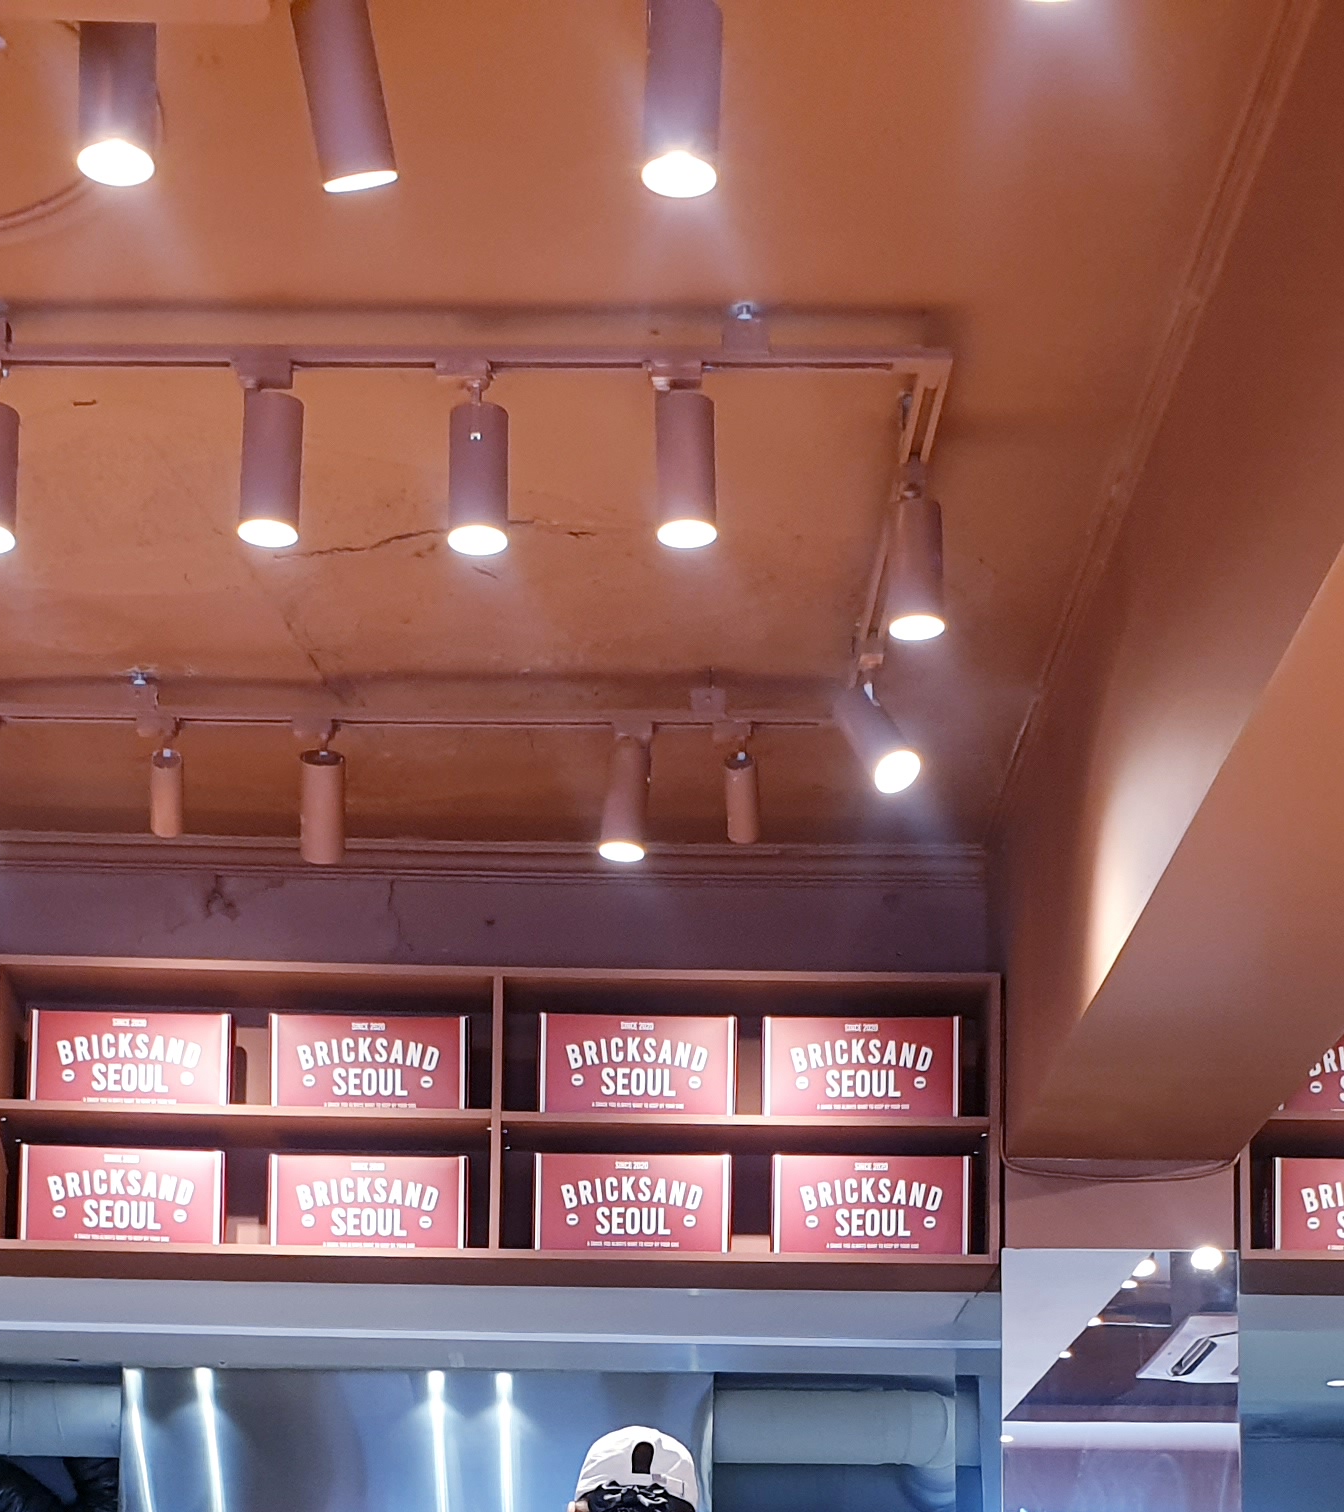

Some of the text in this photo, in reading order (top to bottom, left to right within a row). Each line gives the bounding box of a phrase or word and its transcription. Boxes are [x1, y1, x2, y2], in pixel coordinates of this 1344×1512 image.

[56, 1033, 202, 1069] BRICKSAND
[296, 1037, 440, 1072] BRICKSAND
[565, 1036, 709, 1073] BRICKSAND
[790, 1038, 933, 1073] BRICKSAND
[91, 1062, 168, 1093] SEOUL
[332, 1067, 408, 1097] SEOUL
[600, 1067, 677, 1097] SEOUL
[825, 1069, 901, 1098] SEOUL
[47, 1169, 195, 1206] BRICKSAND
[296, 1177, 439, 1212] BRICKSAND
[560, 1176, 704, 1211] BRICKSAND
[799, 1177, 943, 1212] BRICKSAND
[82, 1199, 161, 1230] SEOUL
[331, 1206, 407, 1237] SEOUL
[595, 1206, 671, 1236] SEOUL
[835, 1206, 911, 1237] SEOUL
